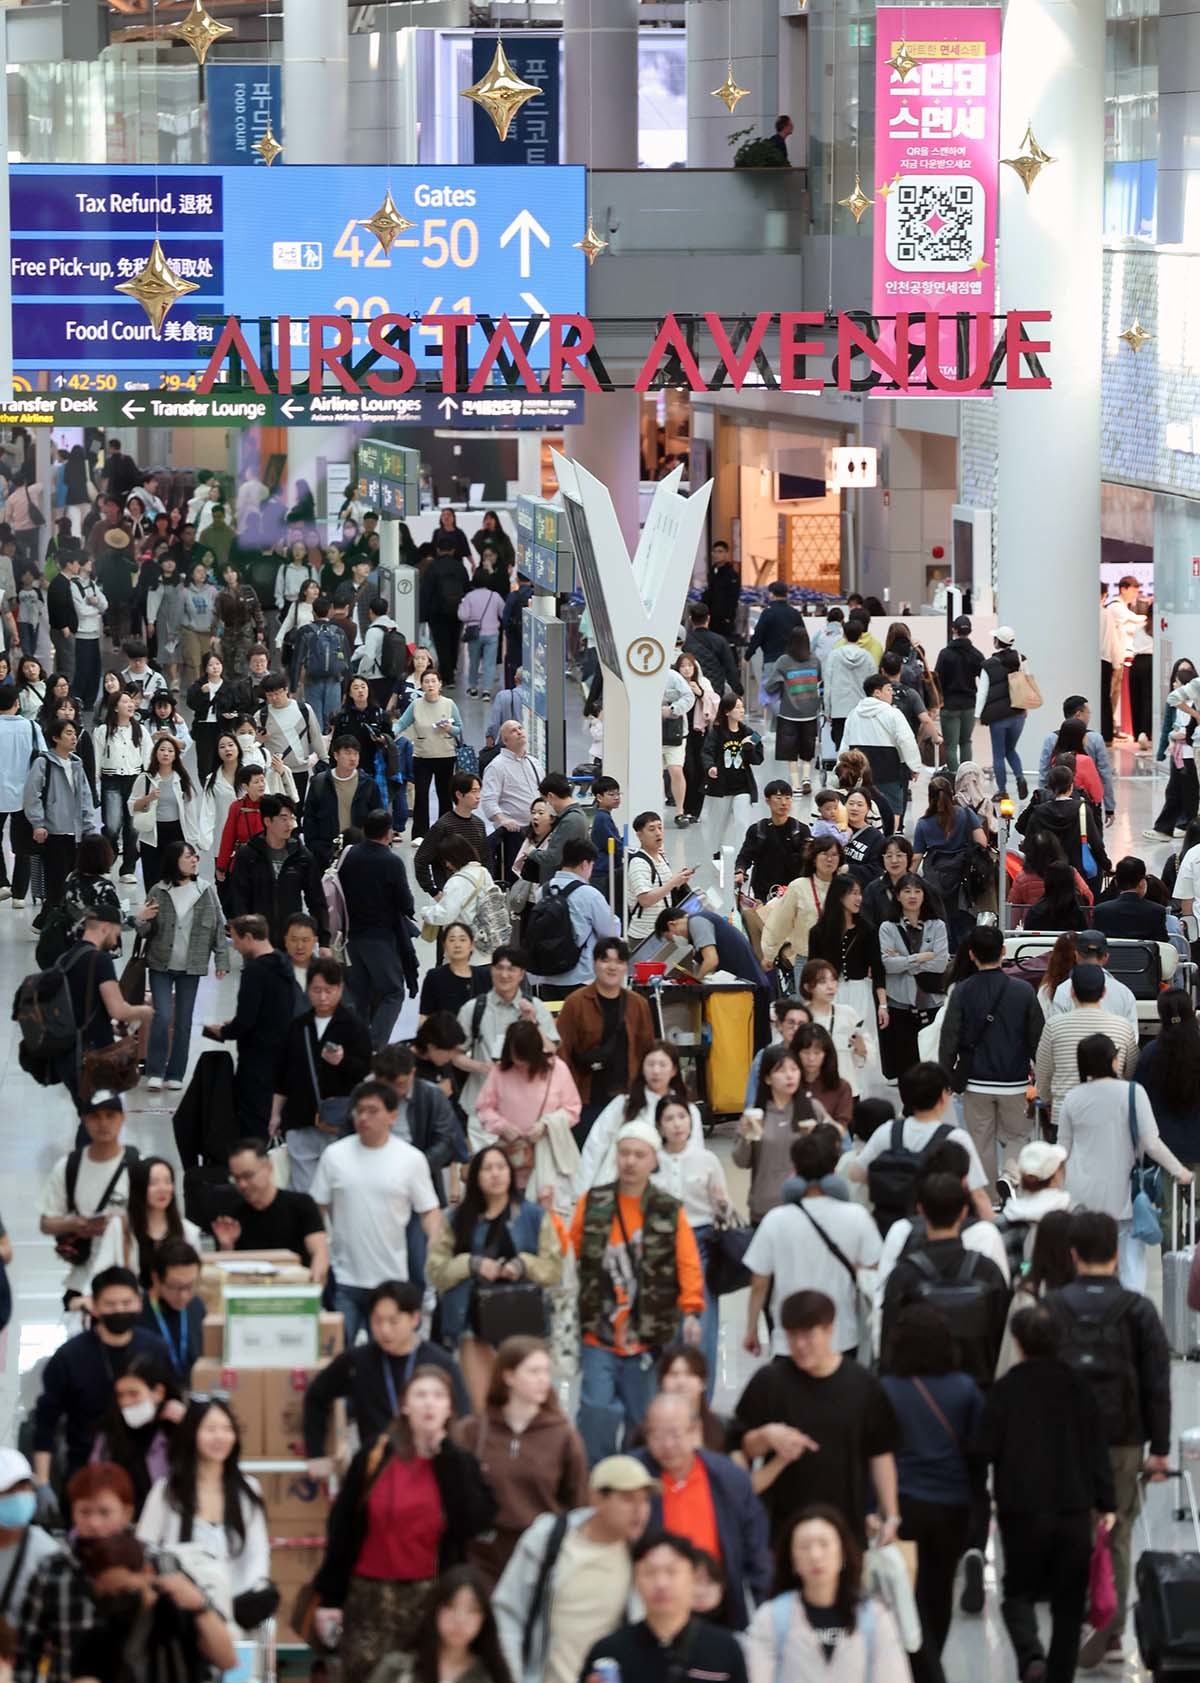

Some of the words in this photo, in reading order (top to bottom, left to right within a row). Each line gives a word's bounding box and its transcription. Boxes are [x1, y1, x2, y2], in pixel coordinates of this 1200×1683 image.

[234, 82, 246, 113] FOOD
[235, 116, 247, 151] COURT
[76, 193, 107, 213] Tax
[110, 192, 176, 215] Refund,
[178, 193, 214, 215] 退税
[414, 184, 477, 207] Gates
[332, 218, 479, 268] 42-50
[11, 258, 46, 276] Free
[49, 257, 114, 280] Pick-up,
[117, 258, 214, 277] 免税领取处
[66, 320, 108, 340] Food
[164, 321, 214, 341] 美食街
[333, 296, 473, 346] 2941
[197, 311, 603, 394] AIRSTAR
[634, 311, 1051, 394] AVENUE
[68, 374, 118, 390] 42-50
[60, 396, 99, 412] Desk
[151, 399, 210, 416] Transfer
[211, 400, 266, 420] Lounge
[310, 396, 359, 411] Airline
[361, 396, 422, 415] Lounges
[0, 414, 19, 423] ther
[20, 413, 54, 423] Airlines
